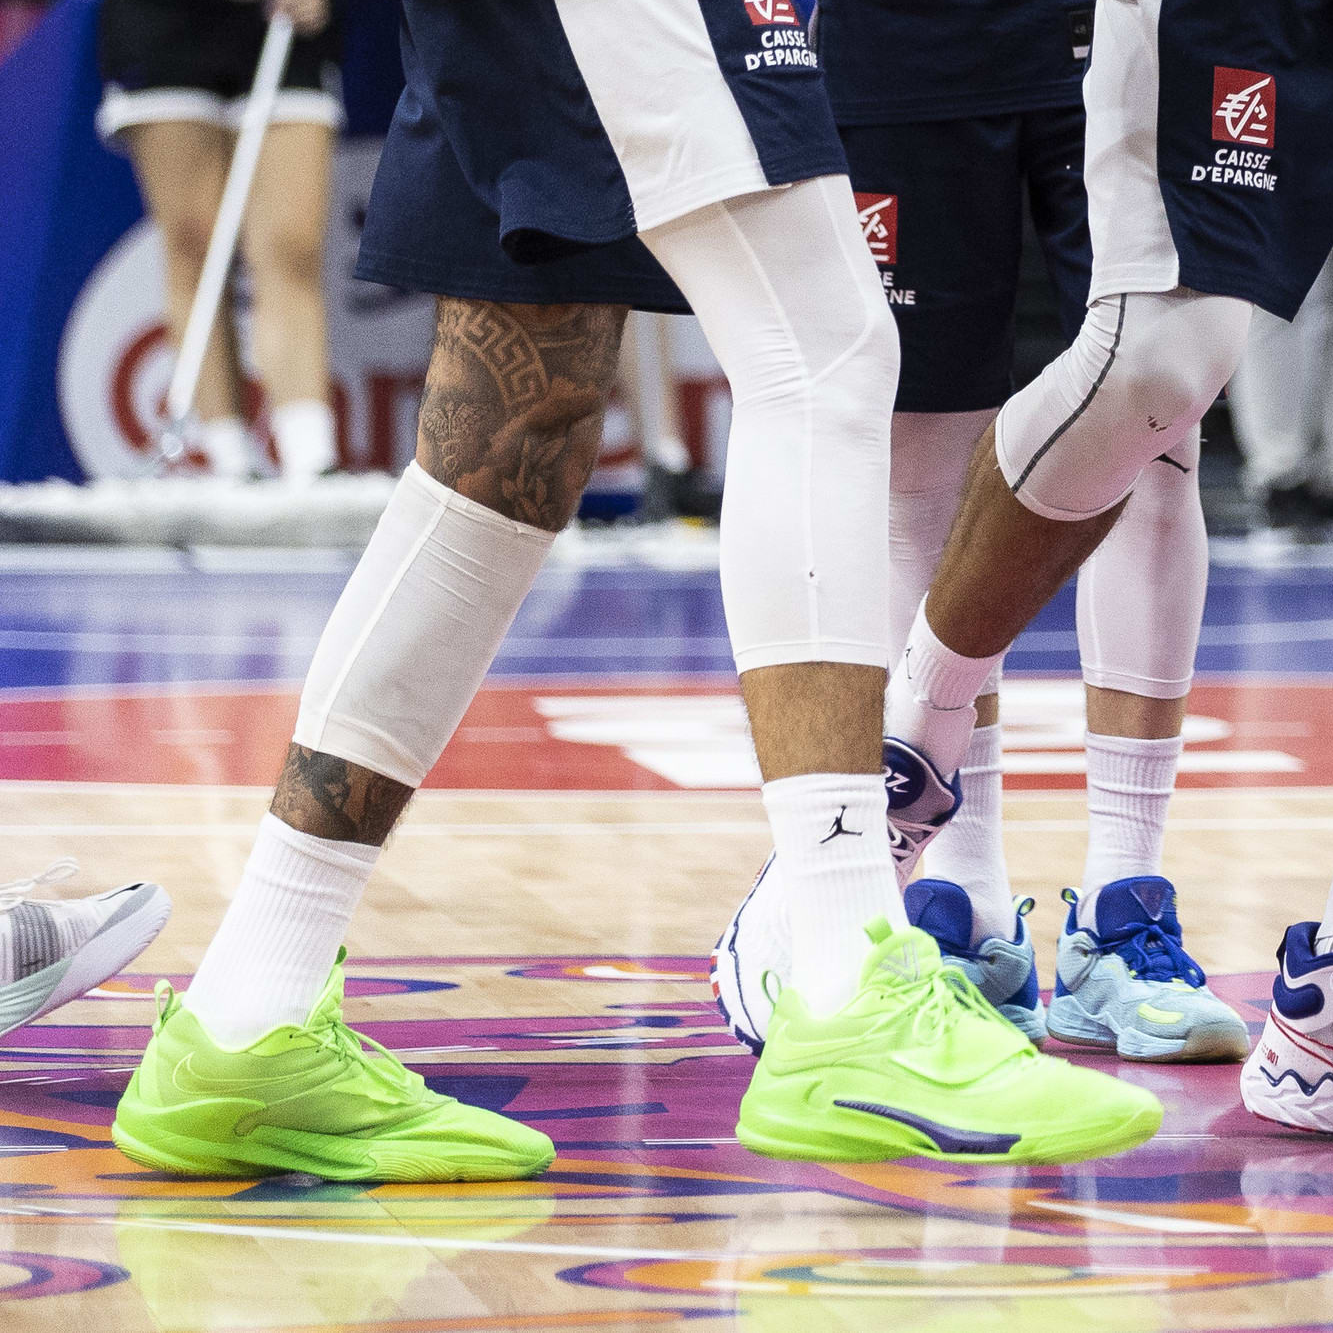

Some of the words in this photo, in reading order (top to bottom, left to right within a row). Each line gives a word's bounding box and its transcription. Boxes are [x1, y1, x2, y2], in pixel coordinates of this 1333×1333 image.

[761, 30, 807, 48] CAISSE
[1214, 148, 1272, 170] CAISSE
[1191, 165, 1278, 192] D'EPARGNE
